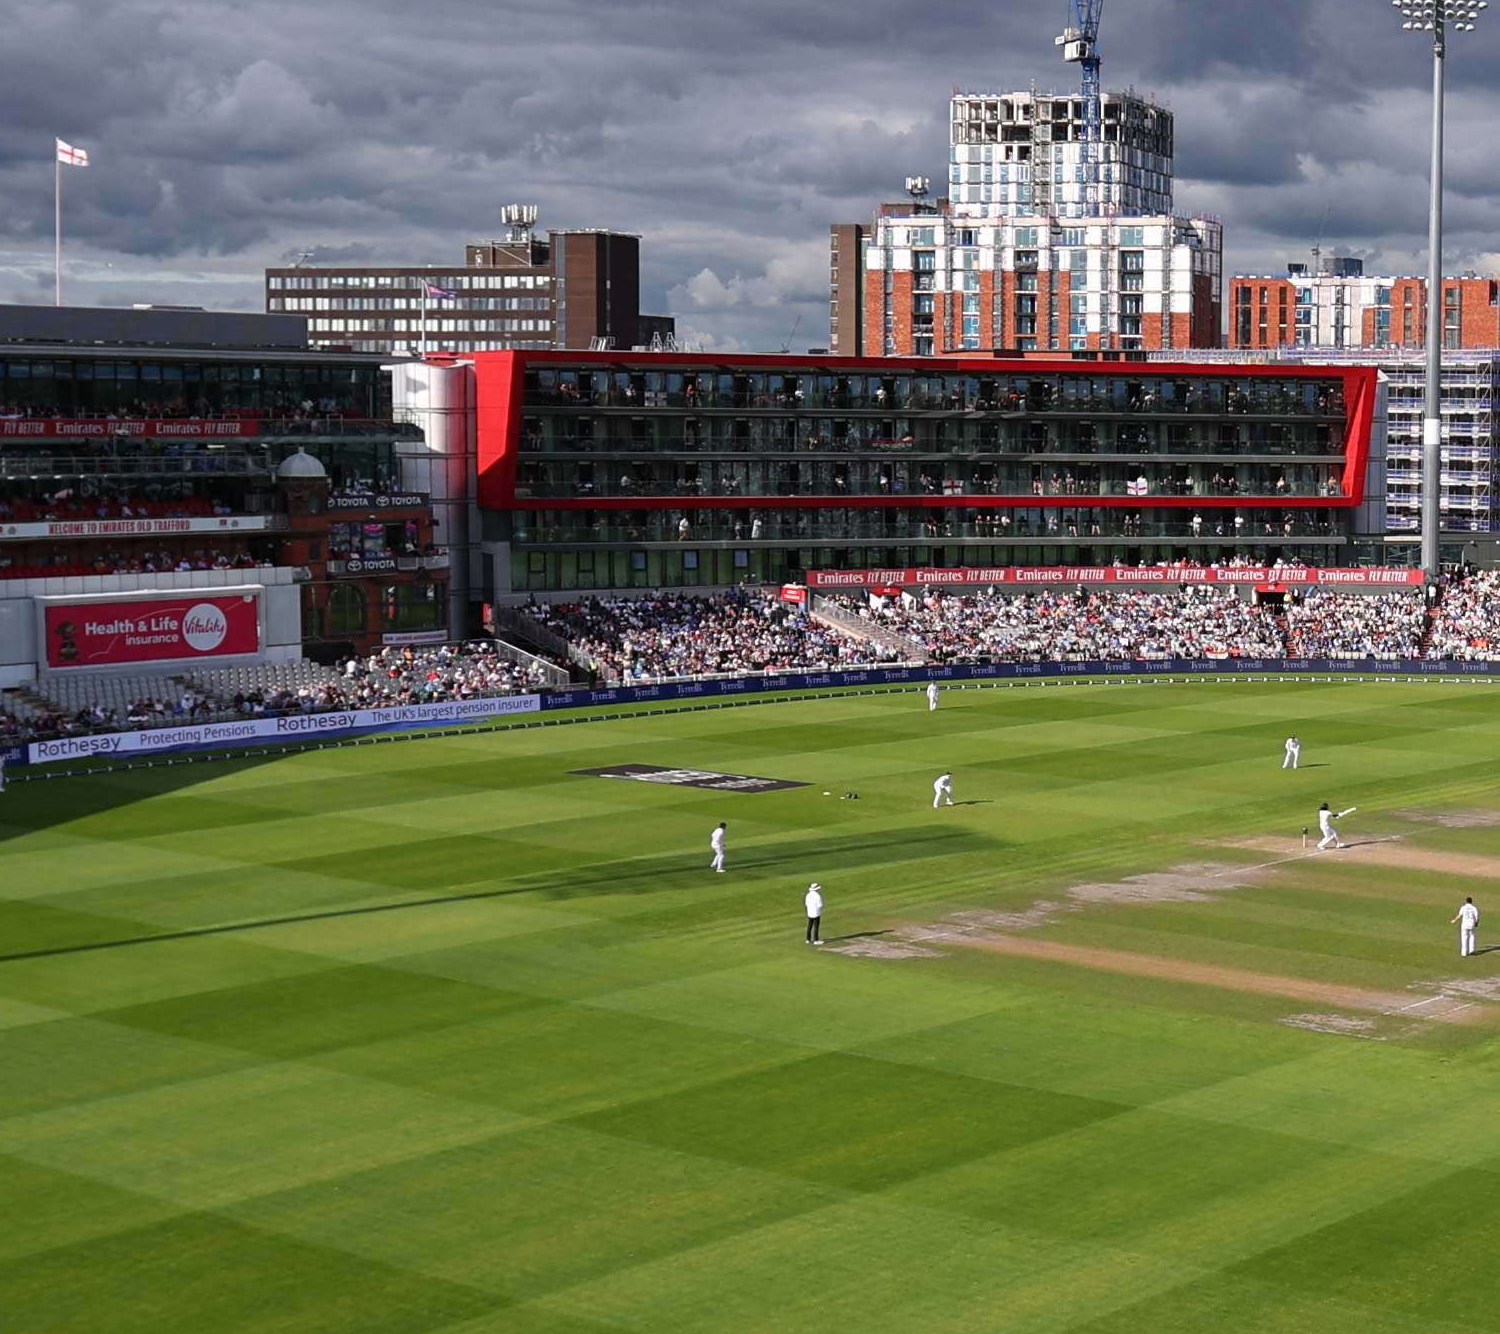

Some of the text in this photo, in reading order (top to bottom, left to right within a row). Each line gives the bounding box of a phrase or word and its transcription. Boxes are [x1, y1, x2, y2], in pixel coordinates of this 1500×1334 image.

[4, 421, 19, 434] FLY
[18, 421, 45, 434] BETTER
[337, 497, 369, 506] TOYOTA
[391, 497, 422, 505] TOYOTA
[48, 519, 190, 534] WELCOME TO EMIRATES OLD TRAFFORD
[364, 560, 396, 569] TOYOTA
[1116, 569, 1206, 581] Emirates FLY BETTER
[1318, 570, 1408, 582] Emirates FLY BETTER
[85, 616, 179, 636] Health & Life
[183, 616, 226, 638] Vitality
[125, 633, 179, 645] insurance
[1280, 659, 1309, 672] Tyrrells
[760, 676, 787, 689] Tyrrells
[38, 697, 534, 758] Rothesay Protecting Pensions Rothesay The UK's largest pension insurer
